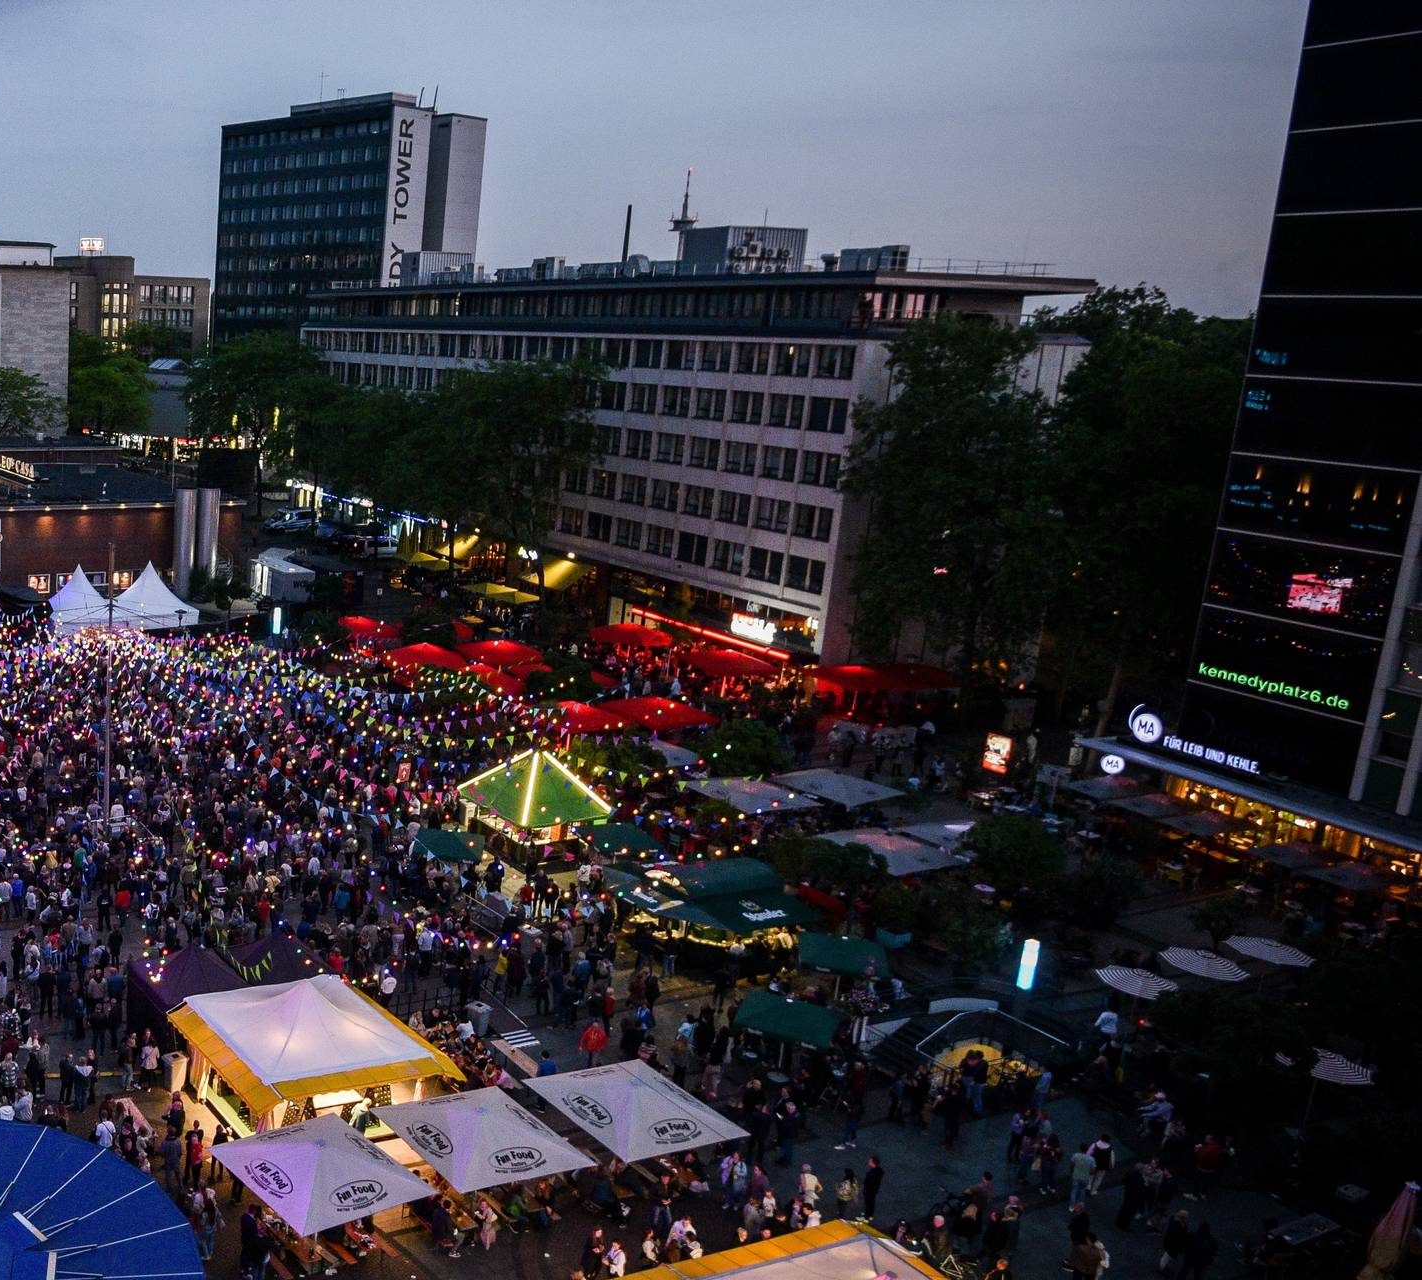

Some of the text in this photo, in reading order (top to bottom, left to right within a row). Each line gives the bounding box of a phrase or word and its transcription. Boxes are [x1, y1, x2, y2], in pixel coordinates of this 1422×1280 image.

[393, 118, 415, 225] TOWER
[15, 459, 35, 478] CASA
[1198, 661, 1350, 711] kennedyplatz6.de
[1137, 718, 1156, 737] MA
[1162, 734, 1261, 775] FÜR LEIB UND KEHLE.
[495, 1154, 511, 1166] Fun
[510, 1150, 535, 1160] Food
[254, 1161, 272, 1174] Fun
[269, 1170, 289, 1190] Food
[335, 1190, 353, 1204] Fun
[350, 1183, 376, 1195] Food
